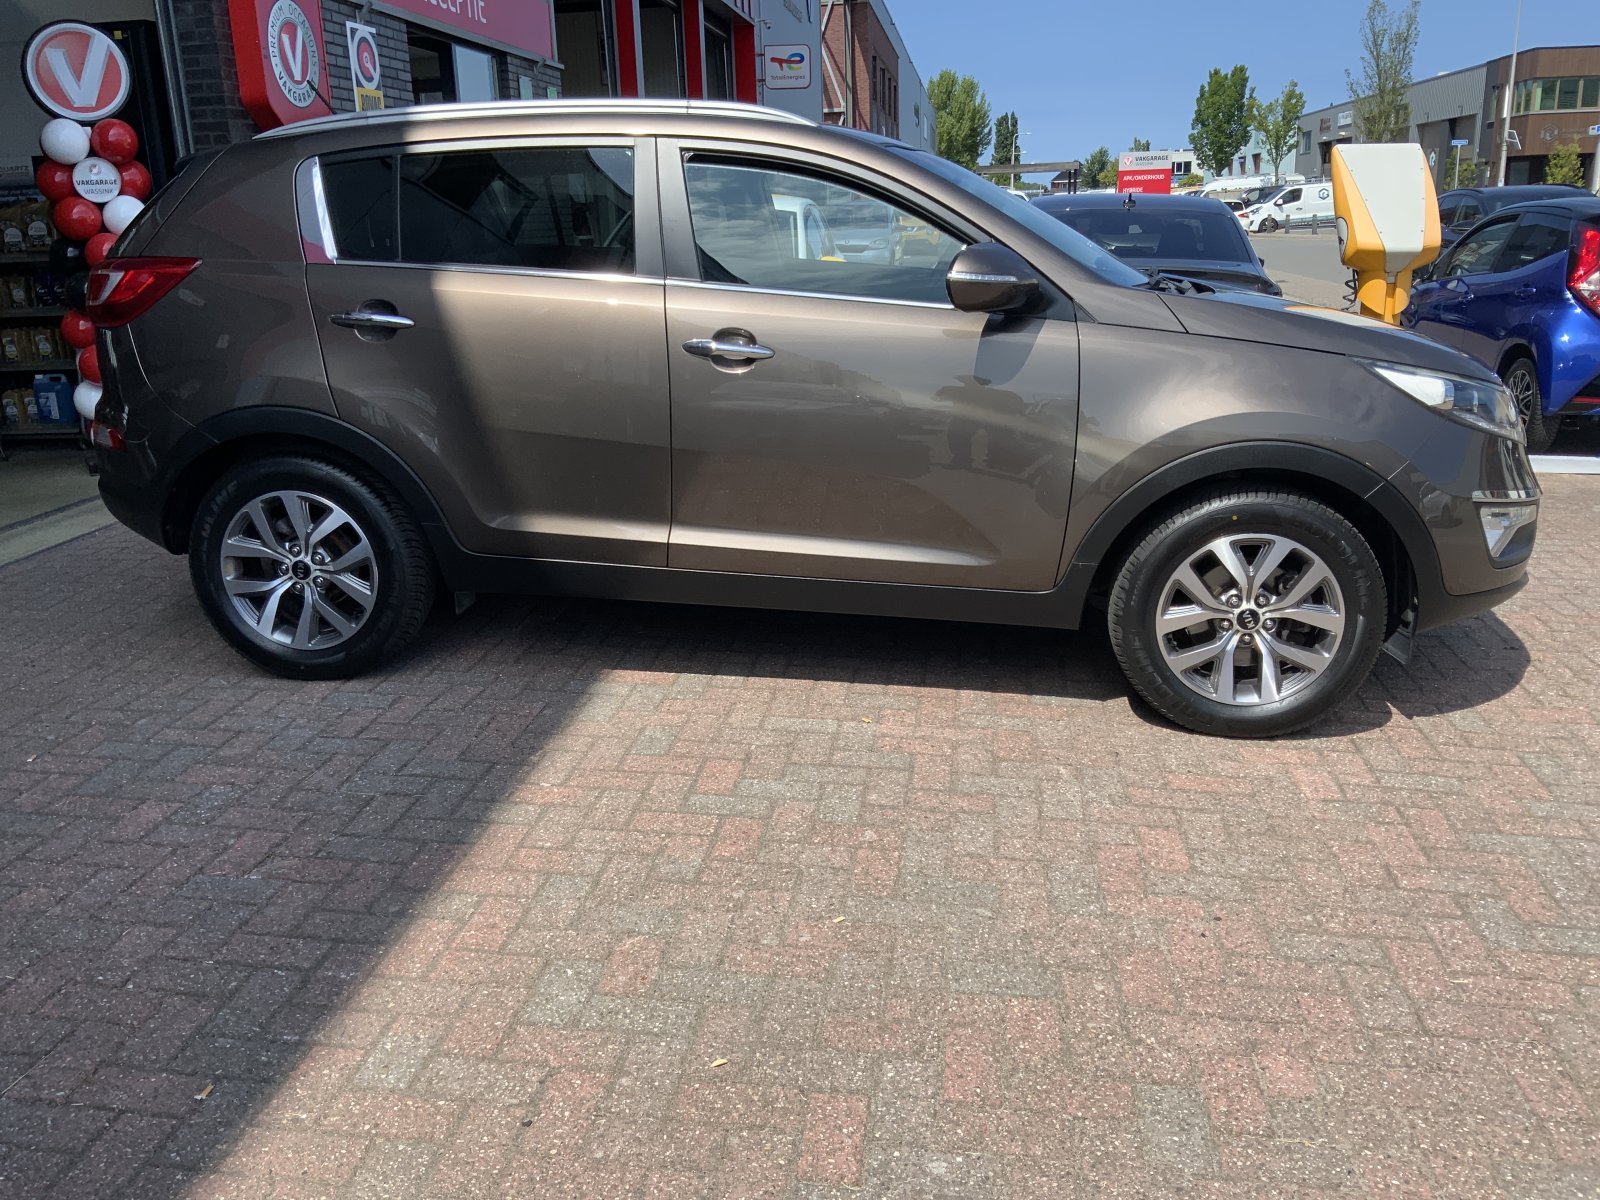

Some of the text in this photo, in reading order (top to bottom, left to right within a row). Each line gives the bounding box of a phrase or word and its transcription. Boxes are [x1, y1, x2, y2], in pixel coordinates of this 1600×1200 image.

[270, 4, 317, 66] PREMIUM OCCASIONS
[278, 71, 317, 104] VAKGARA
